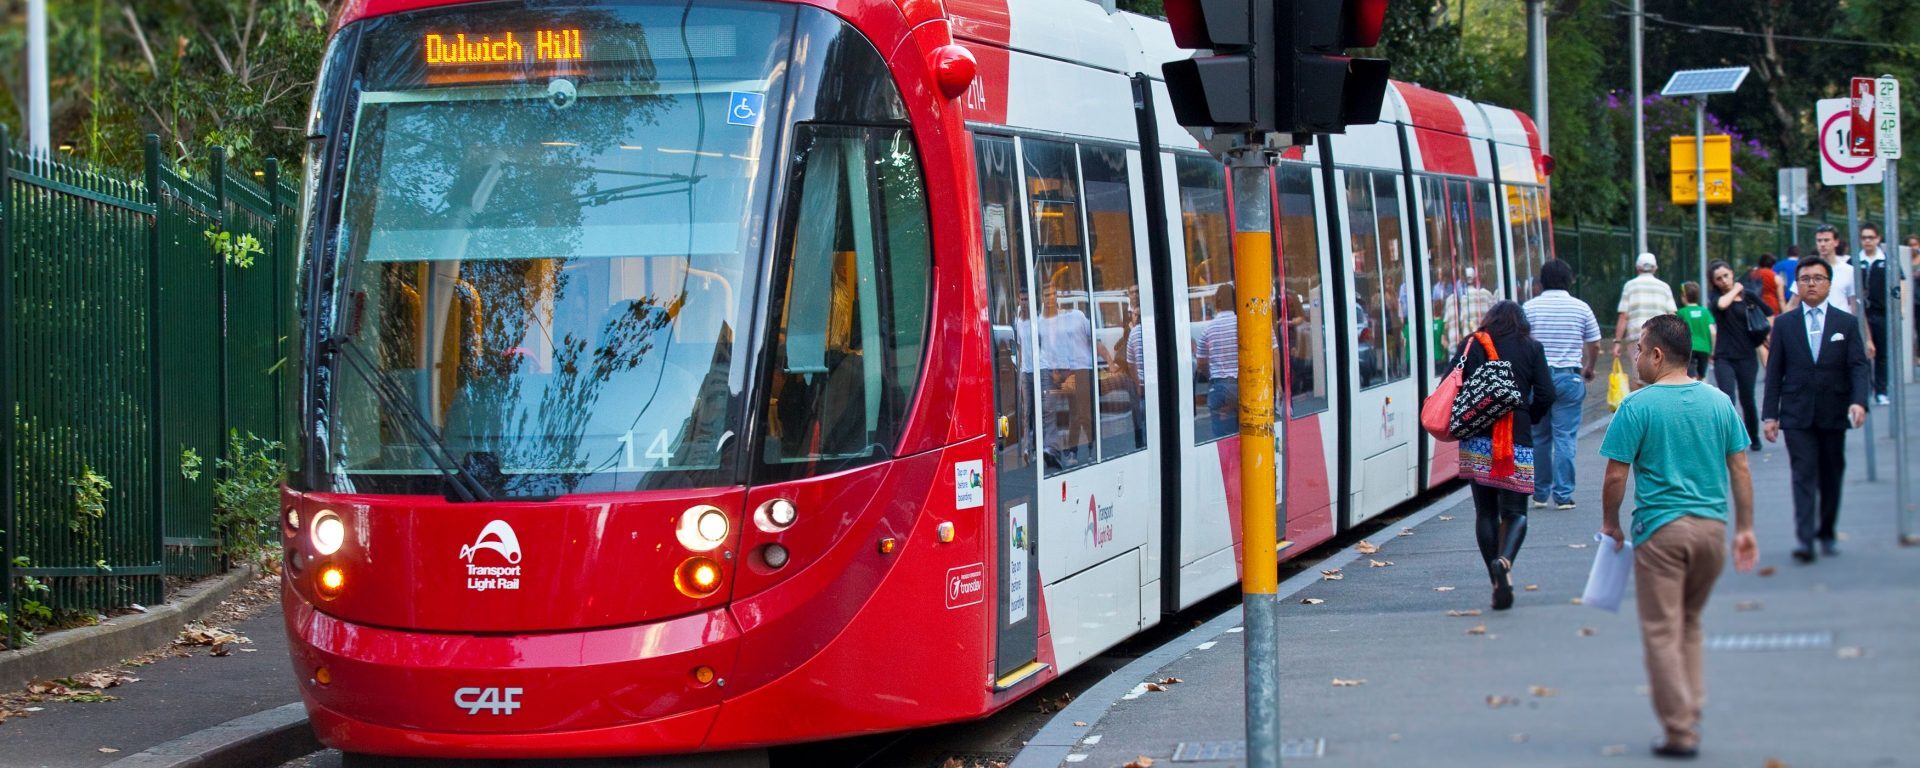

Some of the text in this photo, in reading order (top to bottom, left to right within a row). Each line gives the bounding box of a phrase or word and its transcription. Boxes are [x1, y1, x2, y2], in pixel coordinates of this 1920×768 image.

[426, 29, 582, 63] Dulwich Hill
[1879, 81, 1895, 96] 2P
[1880, 119, 1896, 133] 4P
[616, 428, 674, 468] 14
[1098, 502, 1113, 523] Transport
[466, 564, 521, 578] Transport
[467, 578, 520, 592] Light Rail
[960, 578, 982, 594] transdev
[453, 686, 524, 716] CAF
